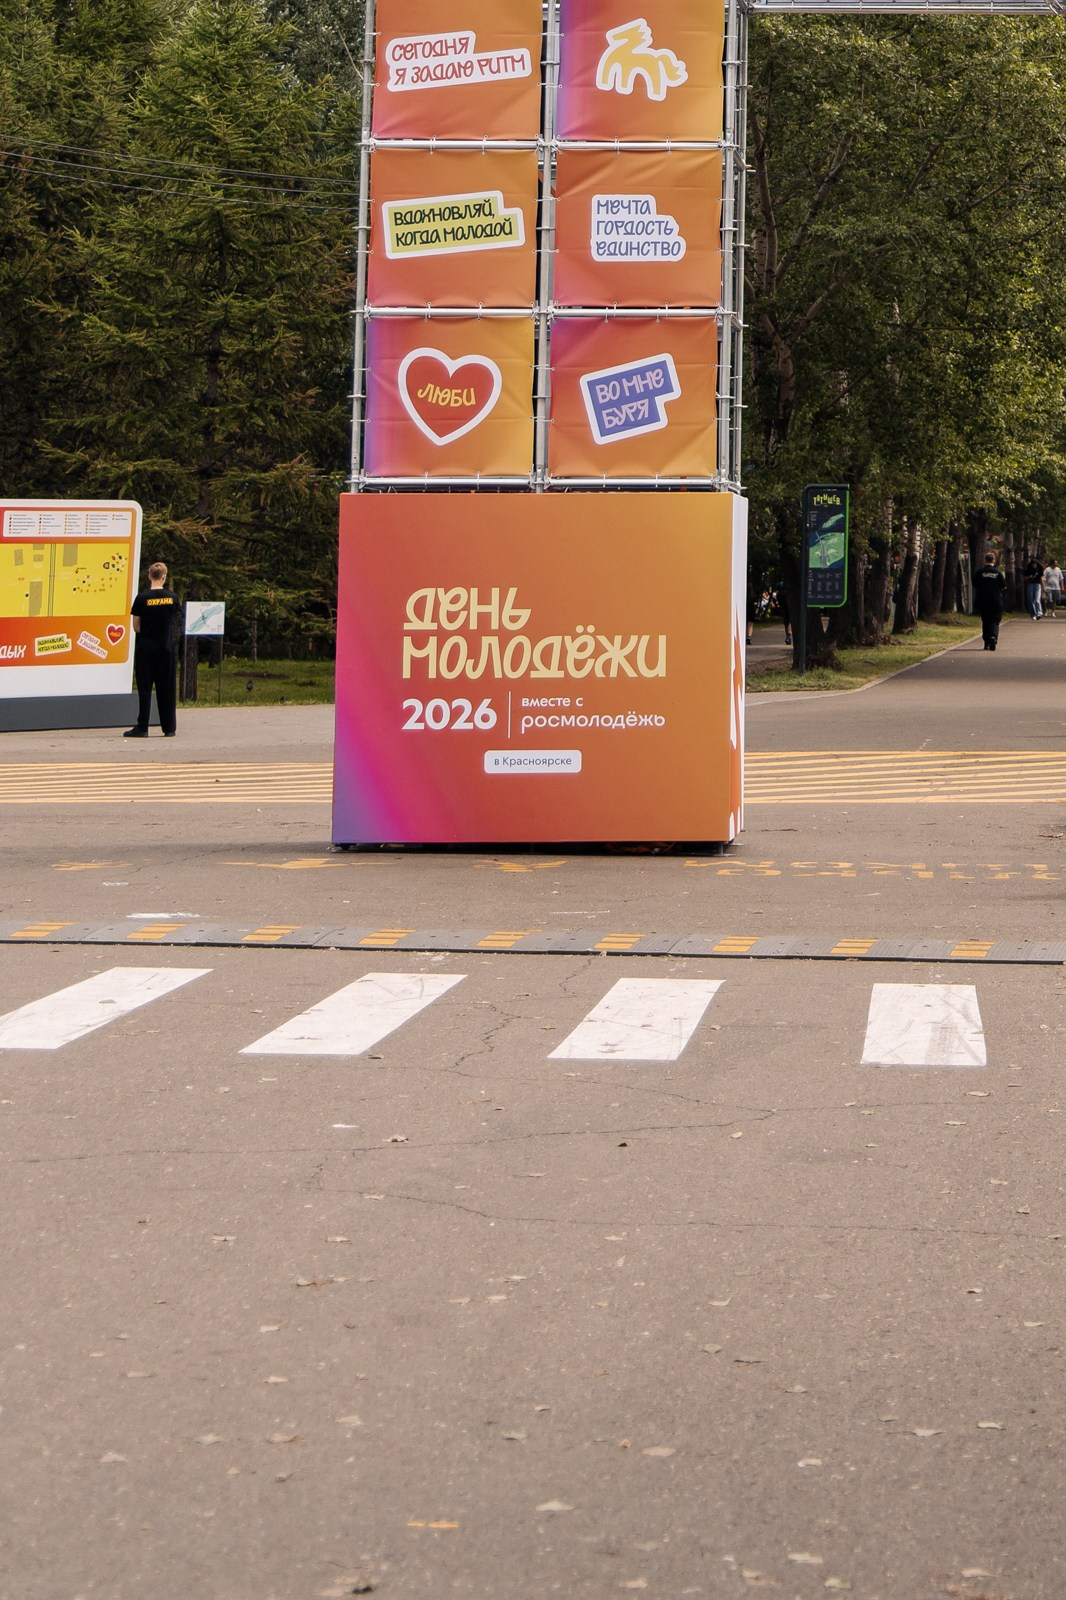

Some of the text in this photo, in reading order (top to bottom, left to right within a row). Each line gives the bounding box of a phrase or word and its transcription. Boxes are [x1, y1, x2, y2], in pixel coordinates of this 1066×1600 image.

[392, 36, 470, 62] СЕГОДНЯ
[394, 54, 527, 86] Я ЗАДАЮ РИТМ
[394, 199, 495, 226] ВДОХНОВЛЯЙ,
[596, 199, 652, 216] МЕЧТА
[396, 216, 513, 248] КОГДА МОЛОДОЙ
[596, 220, 675, 236] ГОРДОСТЬ
[595, 241, 682, 257] ЕДИНСТВО
[417, 382, 476, 406] ЛЮБИ
[594, 367, 665, 404] ВО МНЕ
[602, 399, 650, 429] БУРЯ
[147, 597, 174, 606] ОХРАНА
[401, 698, 497, 730] 2026
[521, 697, 584, 707] вместе с
[521, 710, 666, 734] росмолодёжь
[494, 756, 572, 768] в Красноярске
